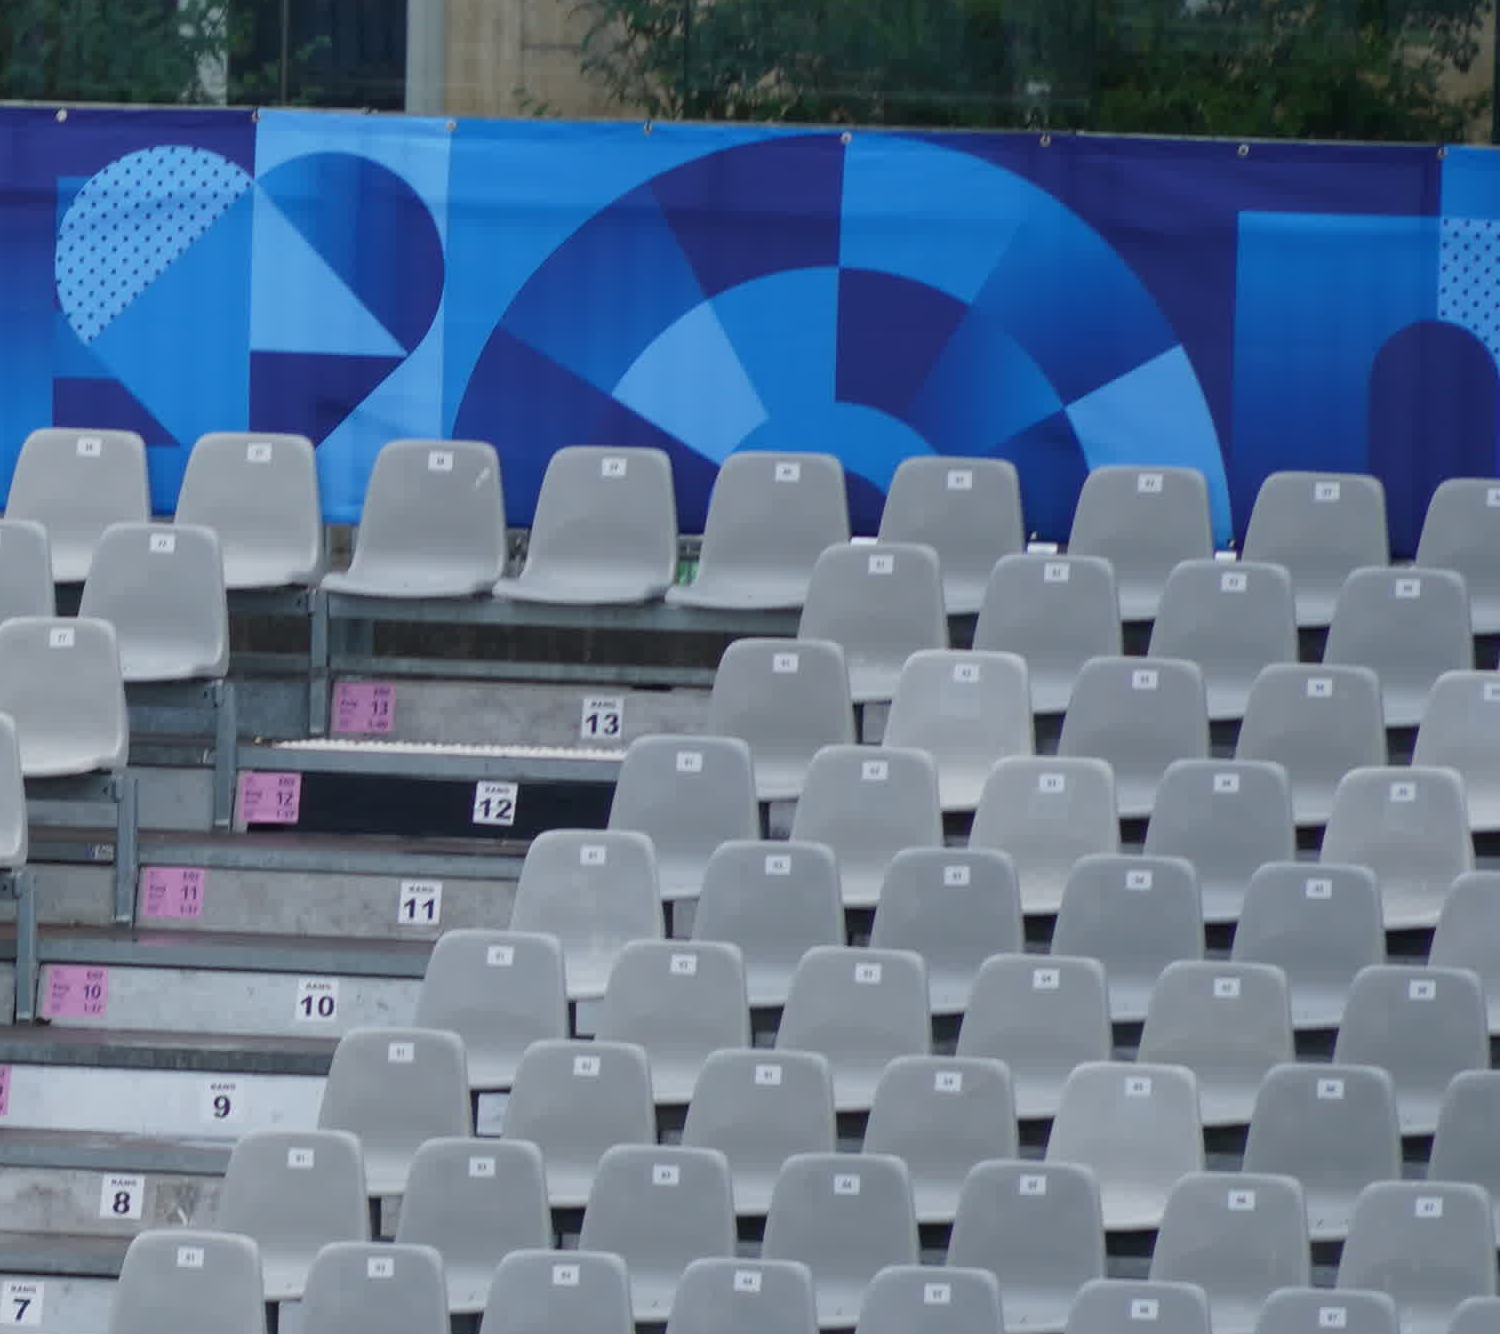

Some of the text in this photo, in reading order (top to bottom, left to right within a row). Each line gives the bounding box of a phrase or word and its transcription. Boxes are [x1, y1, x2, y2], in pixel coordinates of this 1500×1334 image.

[584, 711, 620, 735] 13
[478, 798, 513, 820] 12
[180, 886, 198, 900] 11
[403, 899, 436, 921] 11
[83, 985, 102, 1000] 10
[300, 995, 335, 1017] 10
[213, 1095, 232, 1119] 9
[112, 1191, 131, 1214] 8
[12, 1298, 32, 1321] 7
